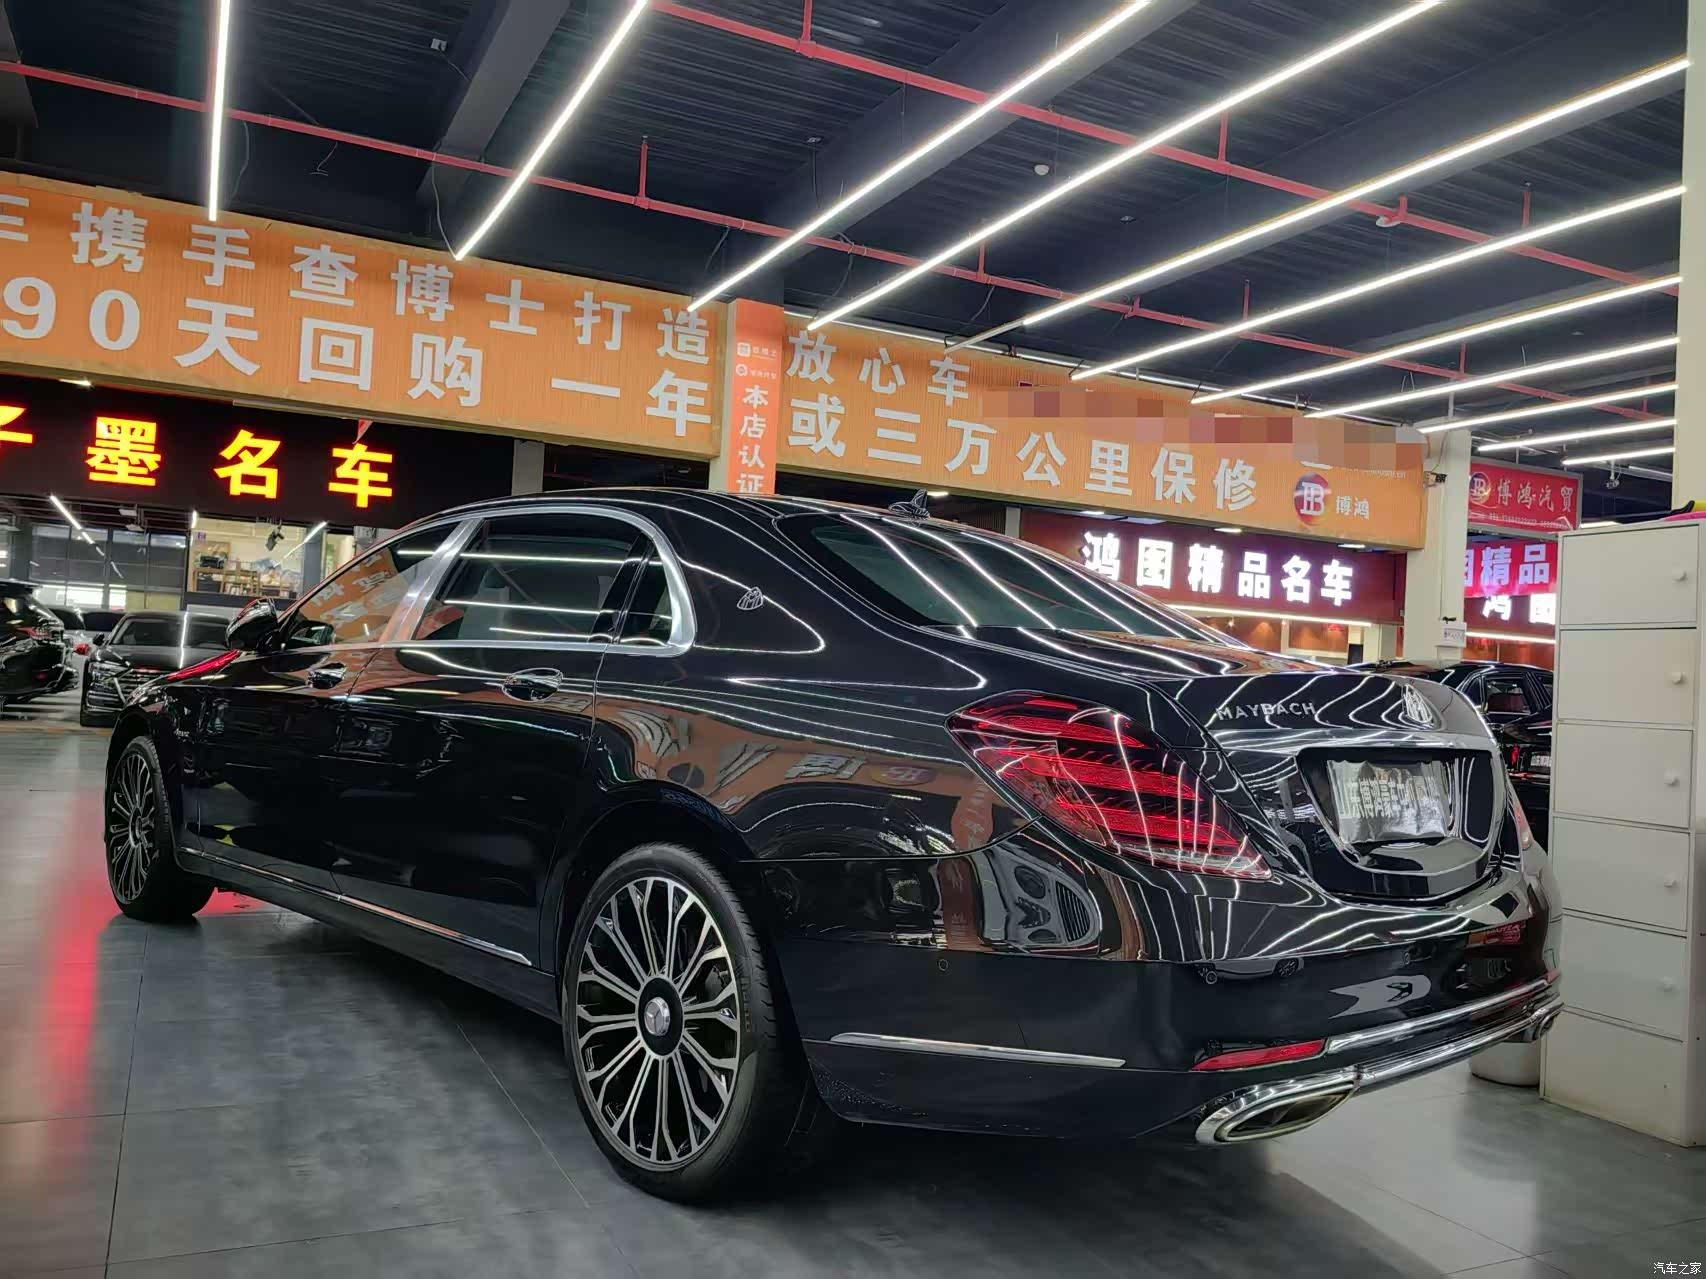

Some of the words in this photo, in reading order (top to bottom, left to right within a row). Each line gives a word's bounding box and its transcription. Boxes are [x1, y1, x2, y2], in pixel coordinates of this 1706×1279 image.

[787, 330, 970, 407] 放心车
[736, 384, 769, 494] 本店认证
[788, 393, 1257, 511] 或三万公里保修
[1080, 531, 1354, 607] 鸿图精品名车
[1215, 701, 1318, 721] MAYBACH
